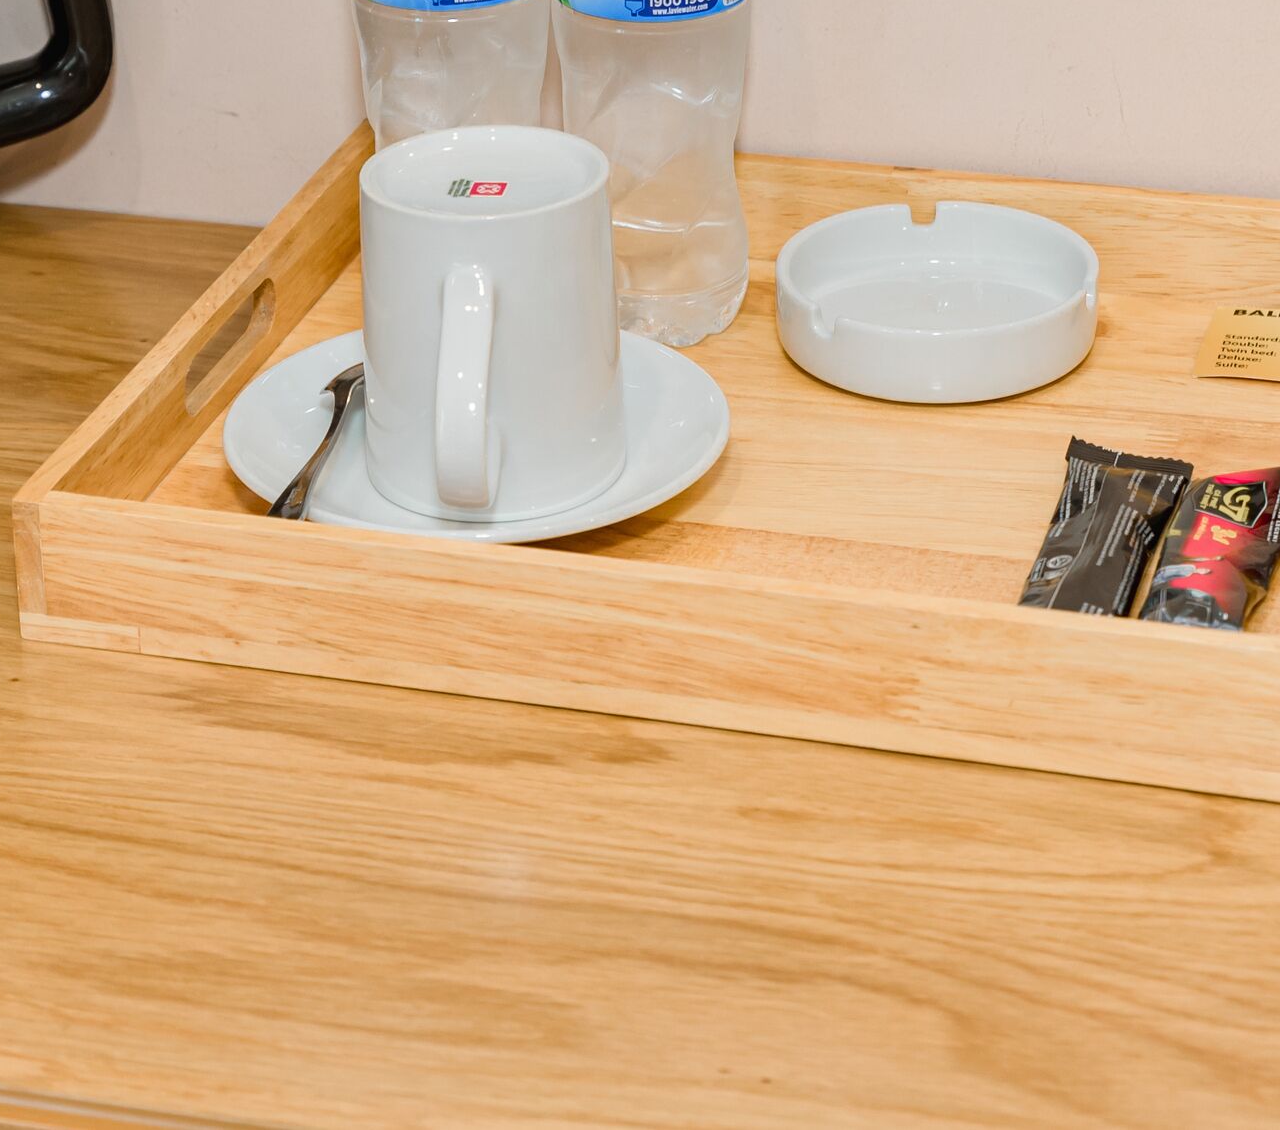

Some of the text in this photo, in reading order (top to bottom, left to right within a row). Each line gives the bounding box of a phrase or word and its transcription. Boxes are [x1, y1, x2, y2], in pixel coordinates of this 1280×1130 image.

[652, 3, 709, 15] www.laviewater.com
[1224, 334, 1280, 343] Standard:
[1222, 340, 1268, 349] Double:
[1250, 348, 1277, 357] bed:
[1217, 354, 1262, 363] Deluxe:
[1215, 361, 1248, 369] Suite:
